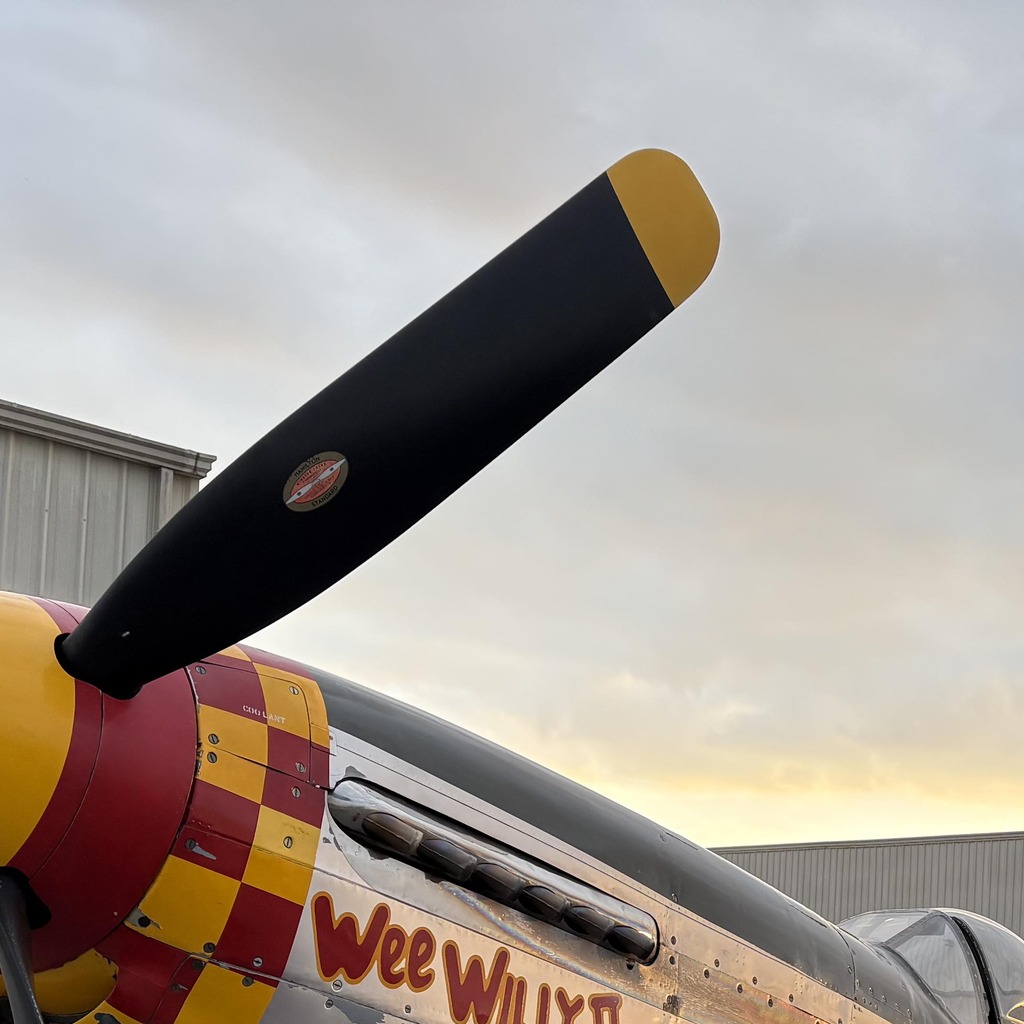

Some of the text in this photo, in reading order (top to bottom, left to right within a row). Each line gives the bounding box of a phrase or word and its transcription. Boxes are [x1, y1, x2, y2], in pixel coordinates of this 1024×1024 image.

[294, 456, 321, 478] HAMILTON
[311, 485, 338, 507] STANDARD
[311, 890, 436, 993] Wee
